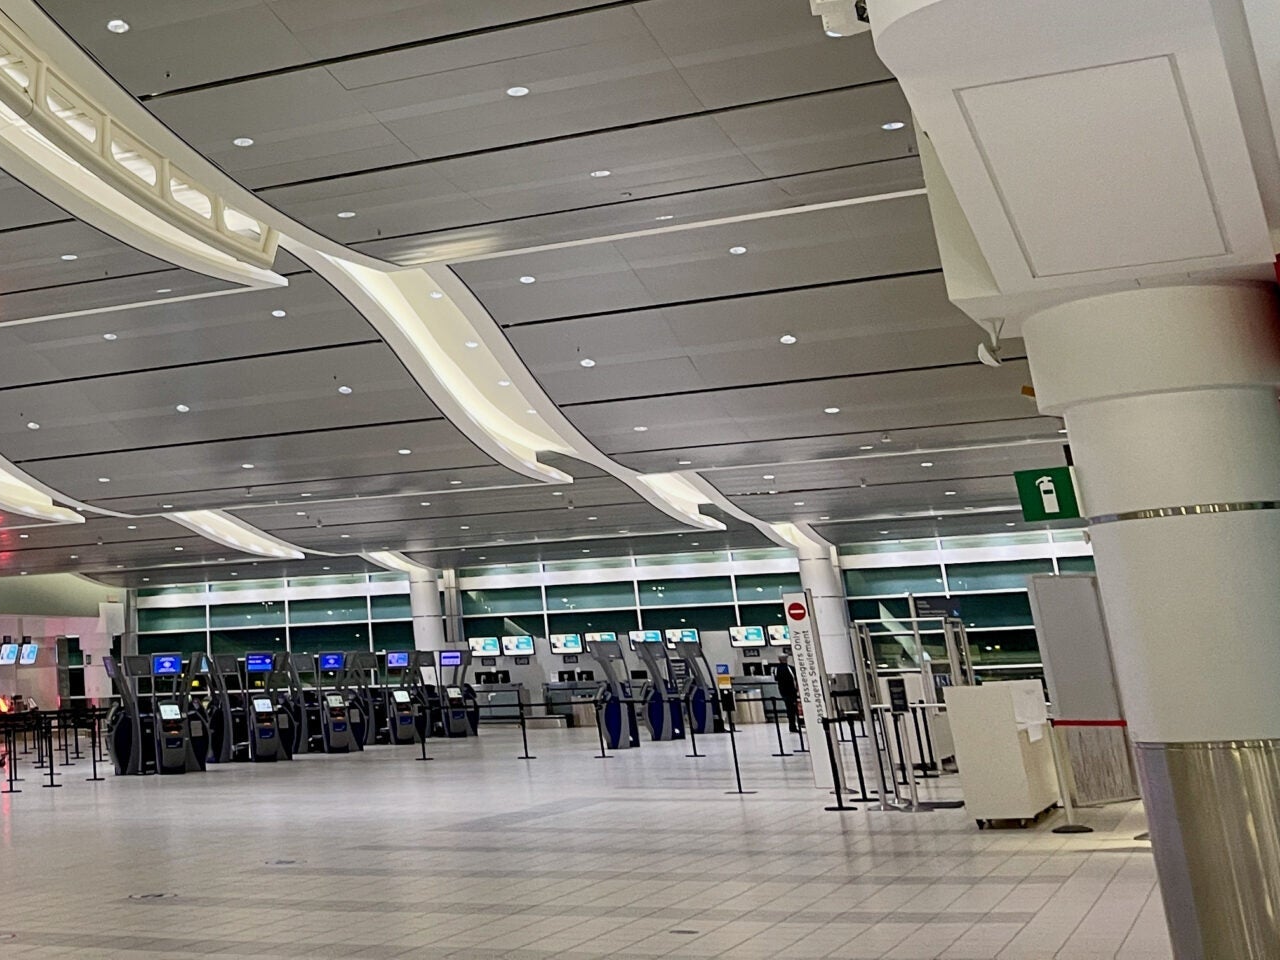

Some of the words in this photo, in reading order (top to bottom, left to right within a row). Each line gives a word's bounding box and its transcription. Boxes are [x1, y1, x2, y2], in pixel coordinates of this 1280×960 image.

[792, 630, 802, 650] Only
[802, 630, 817, 678] Seulement
[798, 652, 811, 703] Passengers
[812, 678, 824, 724] Passagers
